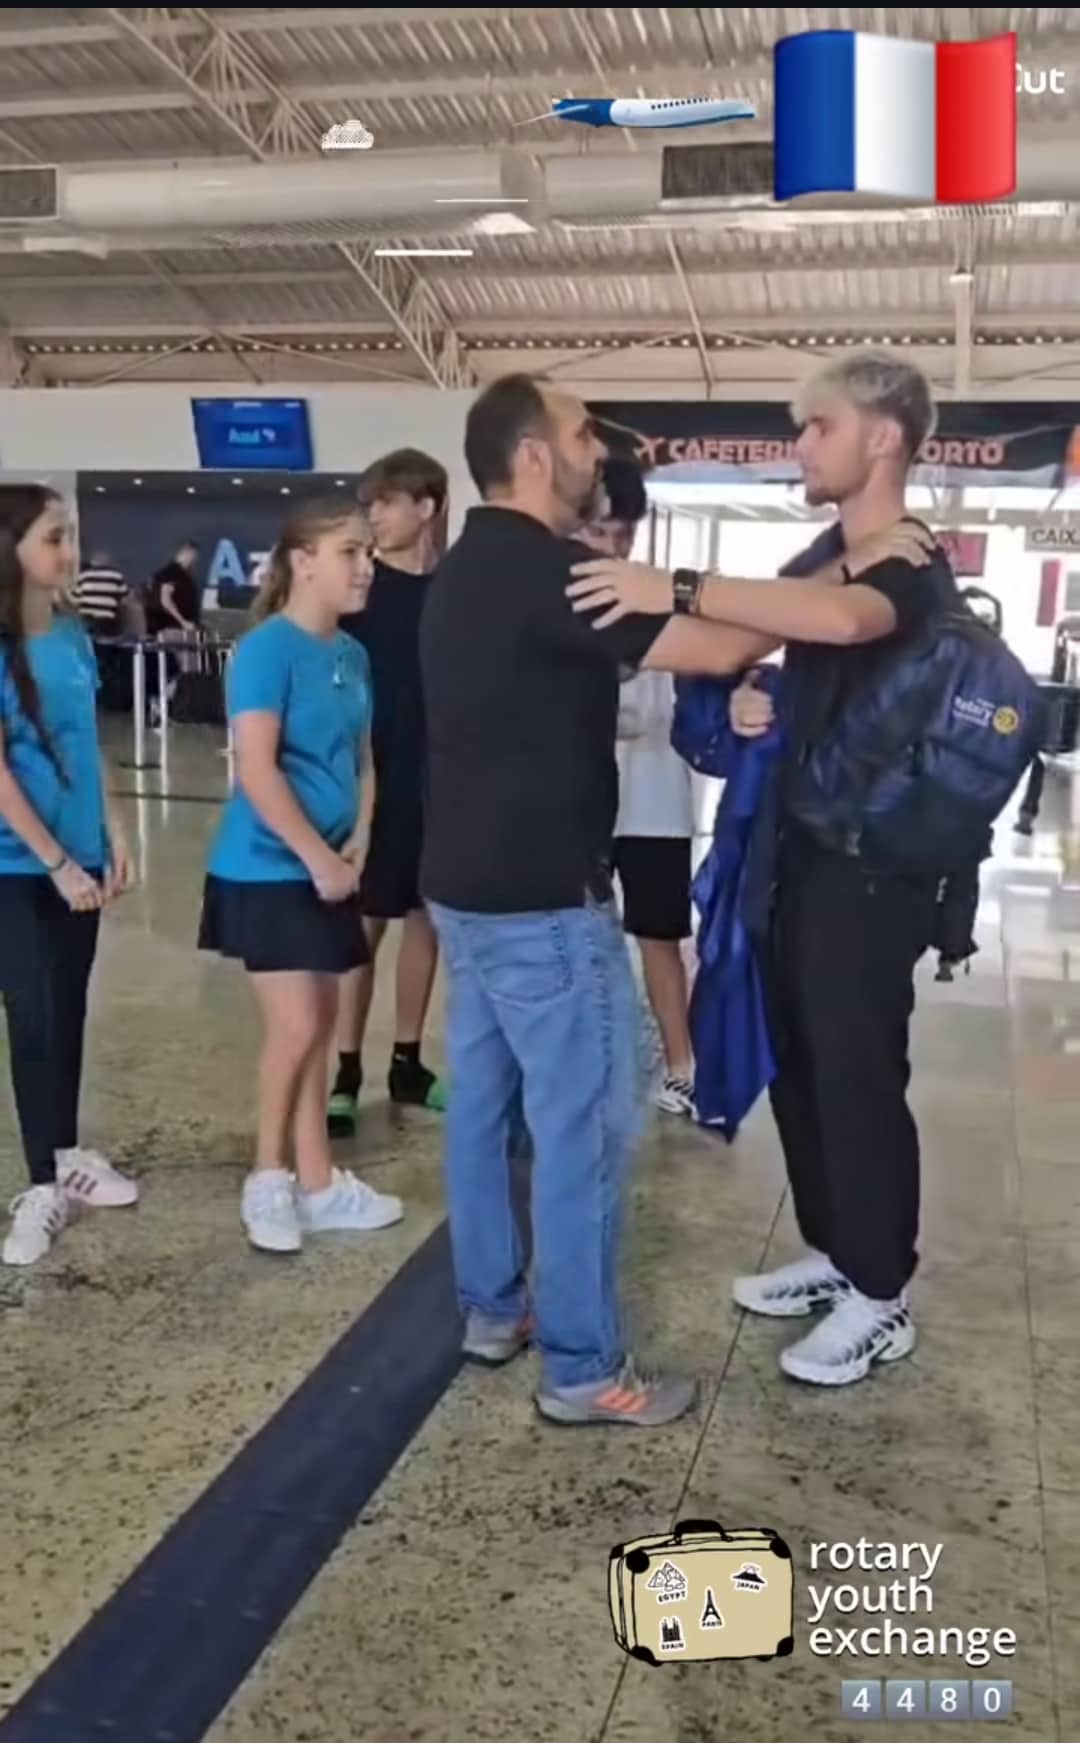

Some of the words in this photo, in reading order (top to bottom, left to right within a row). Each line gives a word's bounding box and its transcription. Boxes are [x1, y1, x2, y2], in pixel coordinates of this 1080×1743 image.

[668, 438, 797, 463] CAFETERI
[921, 439, 1004, 465] ORTO
[1031, 529, 1080, 545] CAIX
